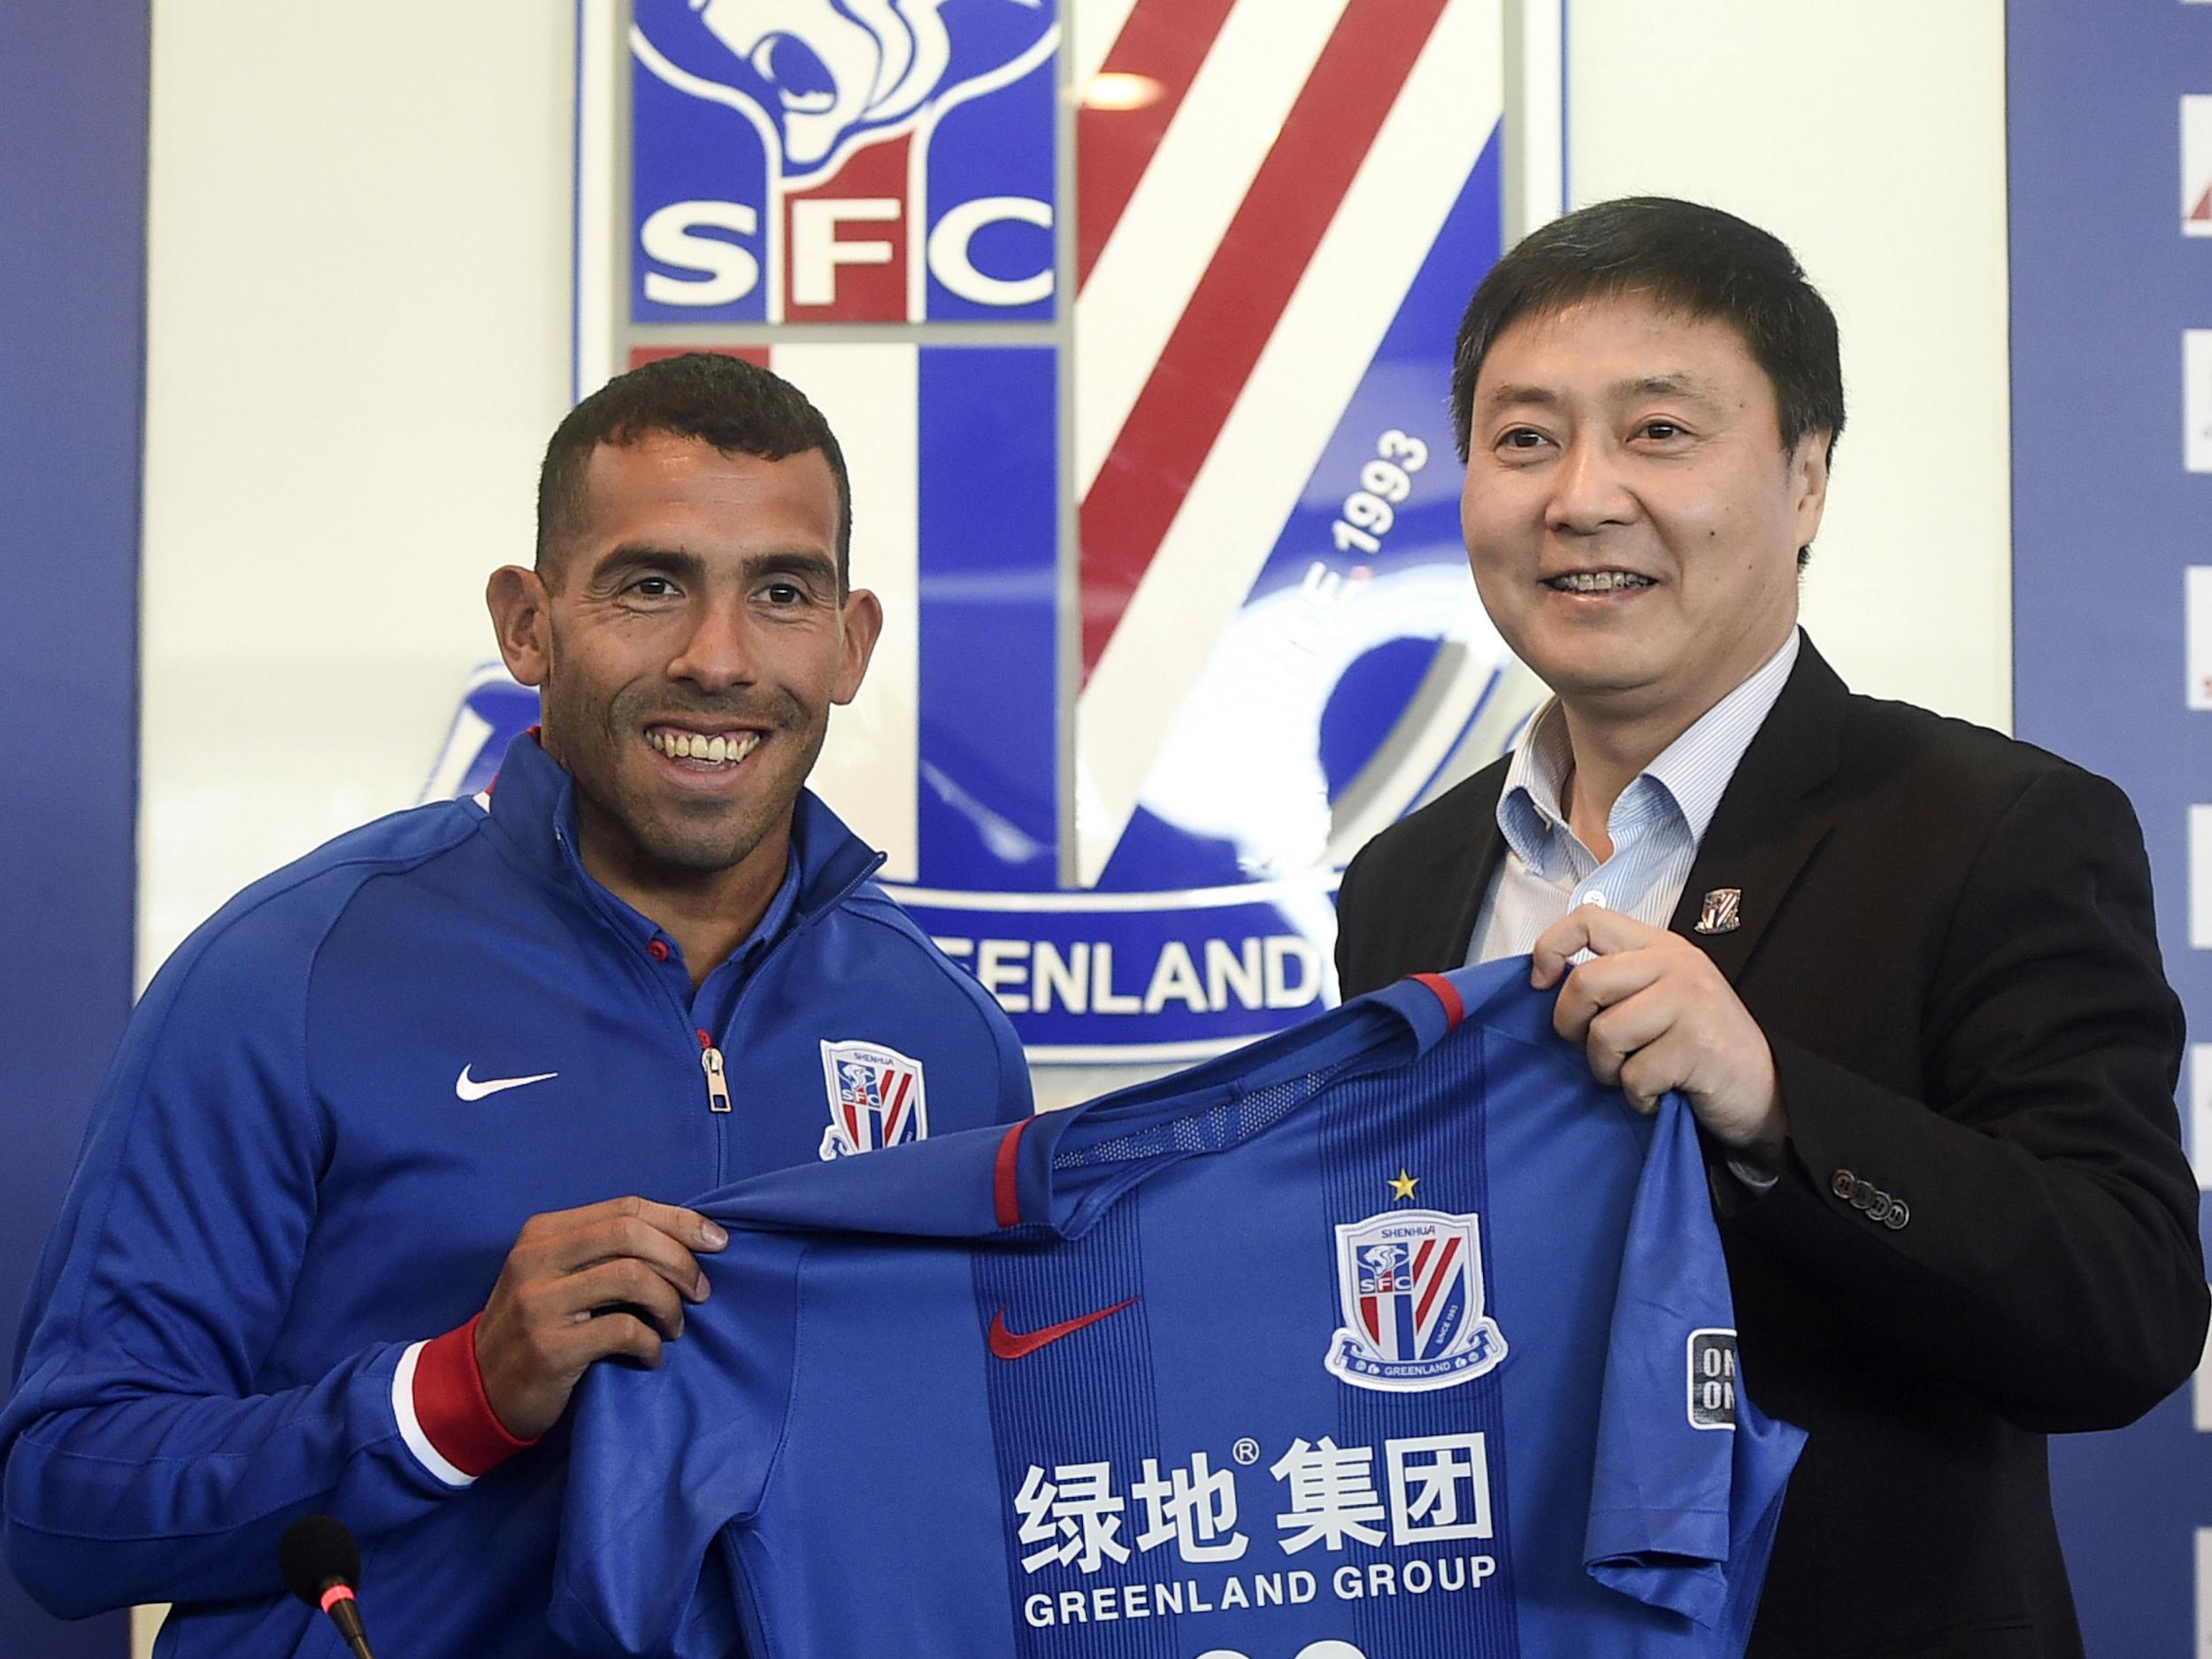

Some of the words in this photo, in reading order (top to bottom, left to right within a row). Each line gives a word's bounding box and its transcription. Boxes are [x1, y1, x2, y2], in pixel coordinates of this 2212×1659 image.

[641, 196, 1054, 306] SFC
[1332, 429, 1429, 555] 1993
[930, 935, 1323, 1014] ENLAND
[841, 1088, 880, 1106] SFC
[1381, 1225, 1436, 1239] SHENHUA
[1360, 1276, 1412, 1293] SFC
[1384, 1361, 1451, 1377] GREENLAND
[1024, 1571, 1317, 1628] GREENLAND
[1333, 1555, 1497, 1600] GROUP
